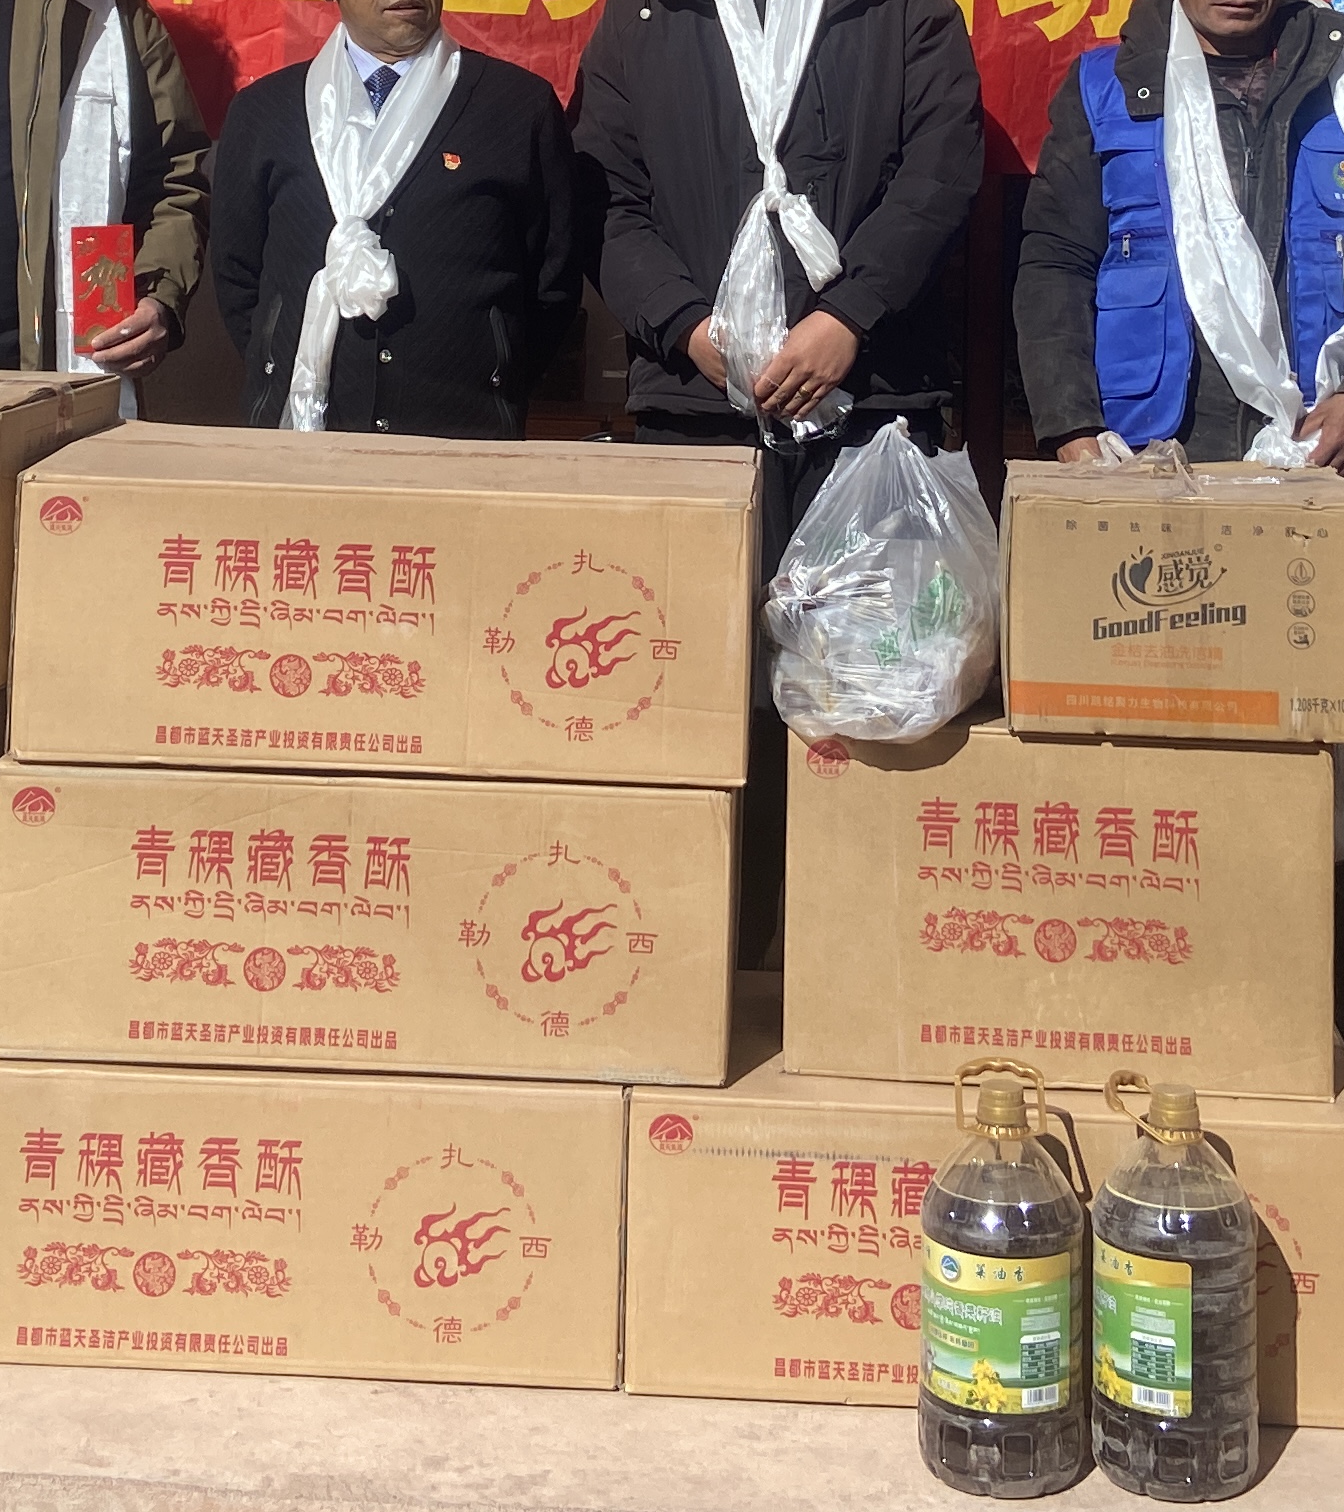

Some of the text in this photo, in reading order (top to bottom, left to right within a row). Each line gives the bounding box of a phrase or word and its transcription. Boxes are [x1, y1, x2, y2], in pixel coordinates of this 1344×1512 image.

[159, 535, 435, 602] 青稞藏香酥
[482, 552, 678, 738] 扎 西 德 勒
[1093, 602, 1247, 641] GoodFeeling
[156, 726, 422, 753] 昌都市蓝天圣洁产业投资有限责任公司出品
[132, 826, 410, 896] 青稞藏香酥
[917, 797, 1198, 868] 青稞藏香酥
[458, 842, 655, 1033] 扎 西 德 勒
[129, 1020, 396, 1049] 昌都市蓝天圣洁产业投资有限责任公司出品
[921, 1025, 1191, 1055] 昌都市蓝天圣洁产业投资有限责任公司出品
[21, 1129, 302, 1201] 青稞藏香酥
[353, 1146, 550, 1342] 扎 西 德 勒
[1291, 1272, 1319, 1295] 西
[17, 1327, 287, 1356] 昌都市蓝天圣洁产业投资有限责任公司出品
